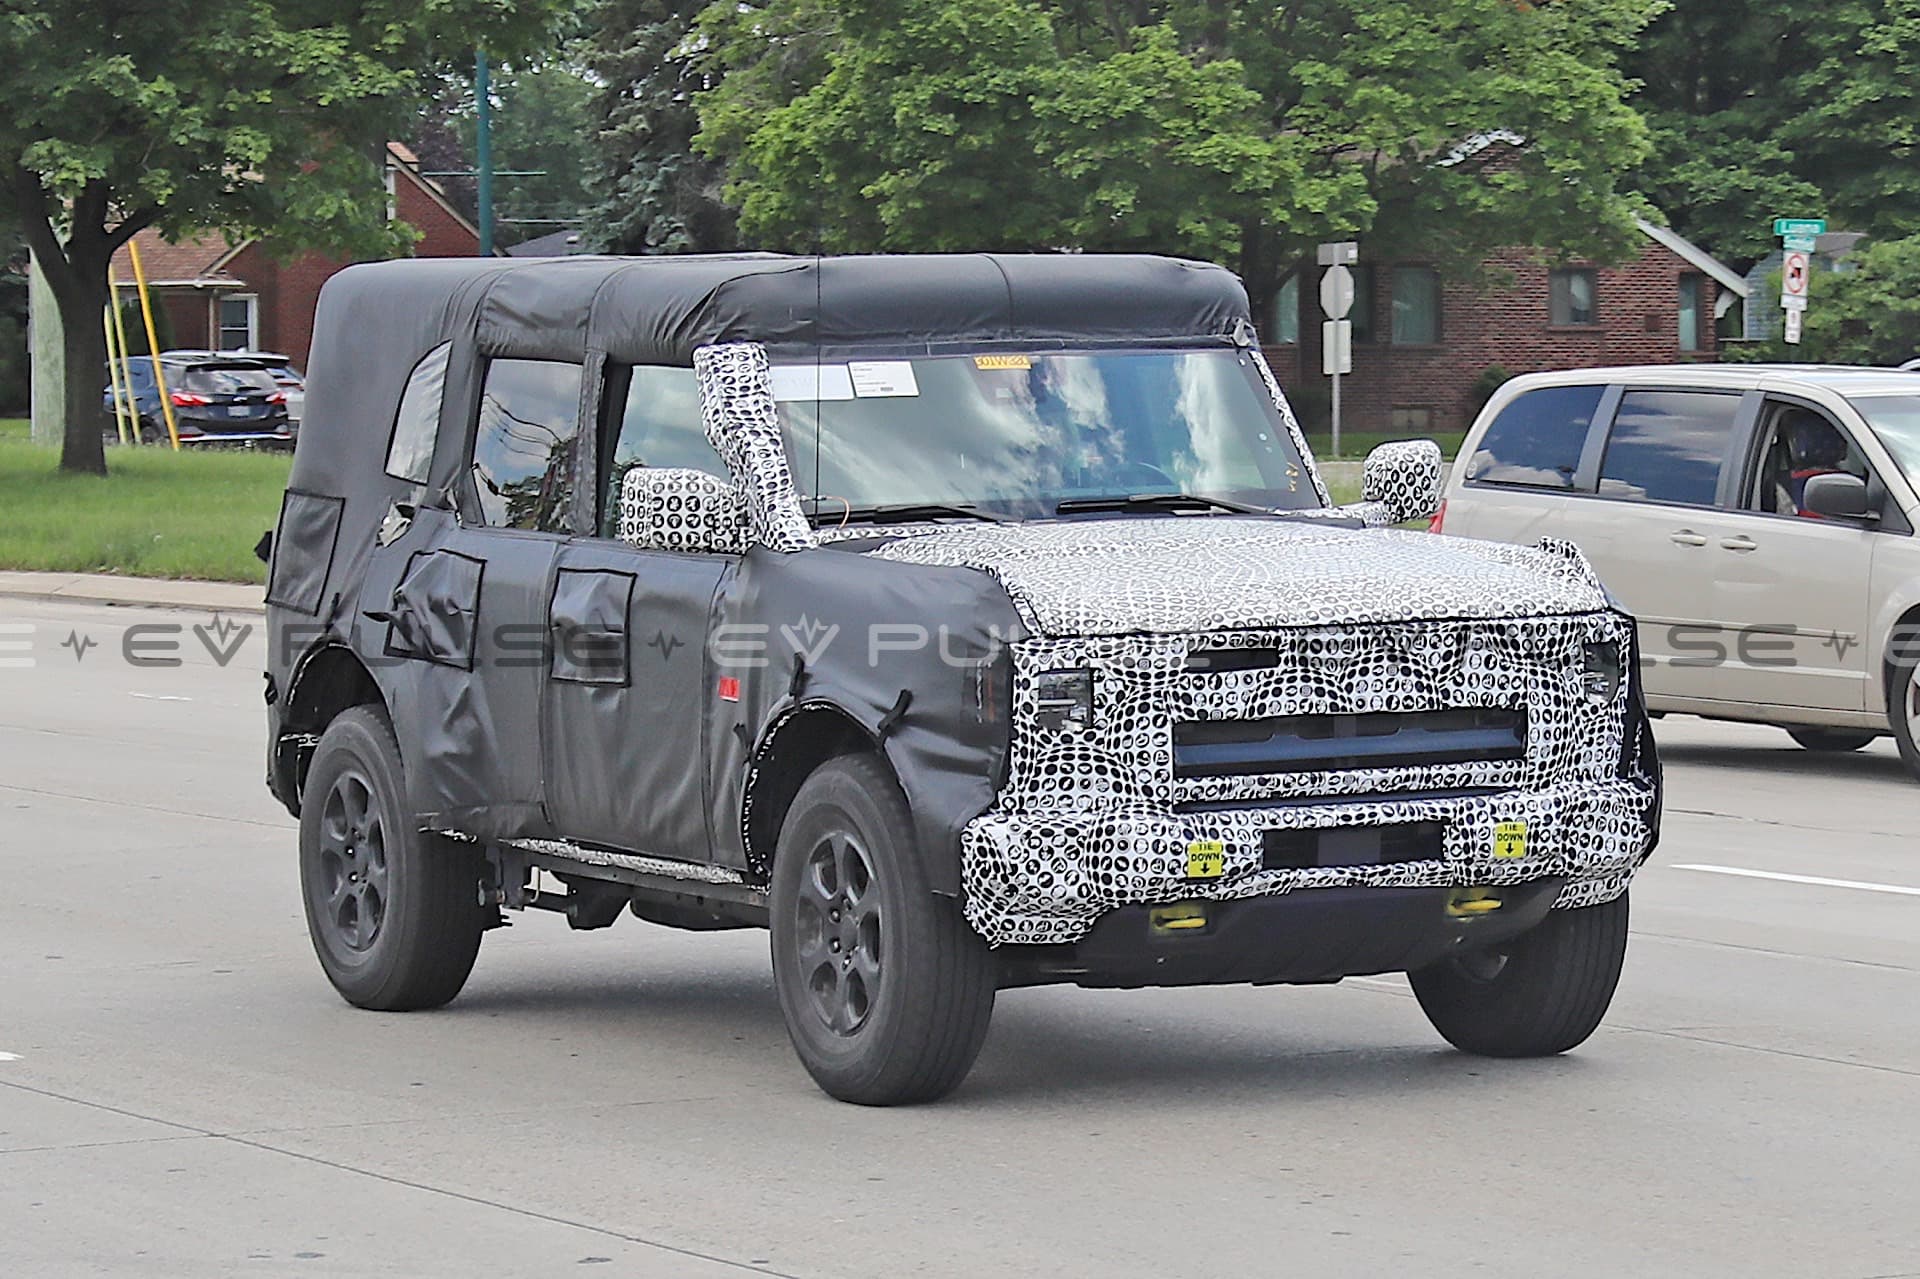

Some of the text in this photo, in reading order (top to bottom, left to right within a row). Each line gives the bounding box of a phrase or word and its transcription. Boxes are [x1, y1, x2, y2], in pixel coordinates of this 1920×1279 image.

[1497, 833, 1523, 841] DOWN
[1198, 843, 1213, 851] TIE
[1191, 853, 1220, 861] DOWN
